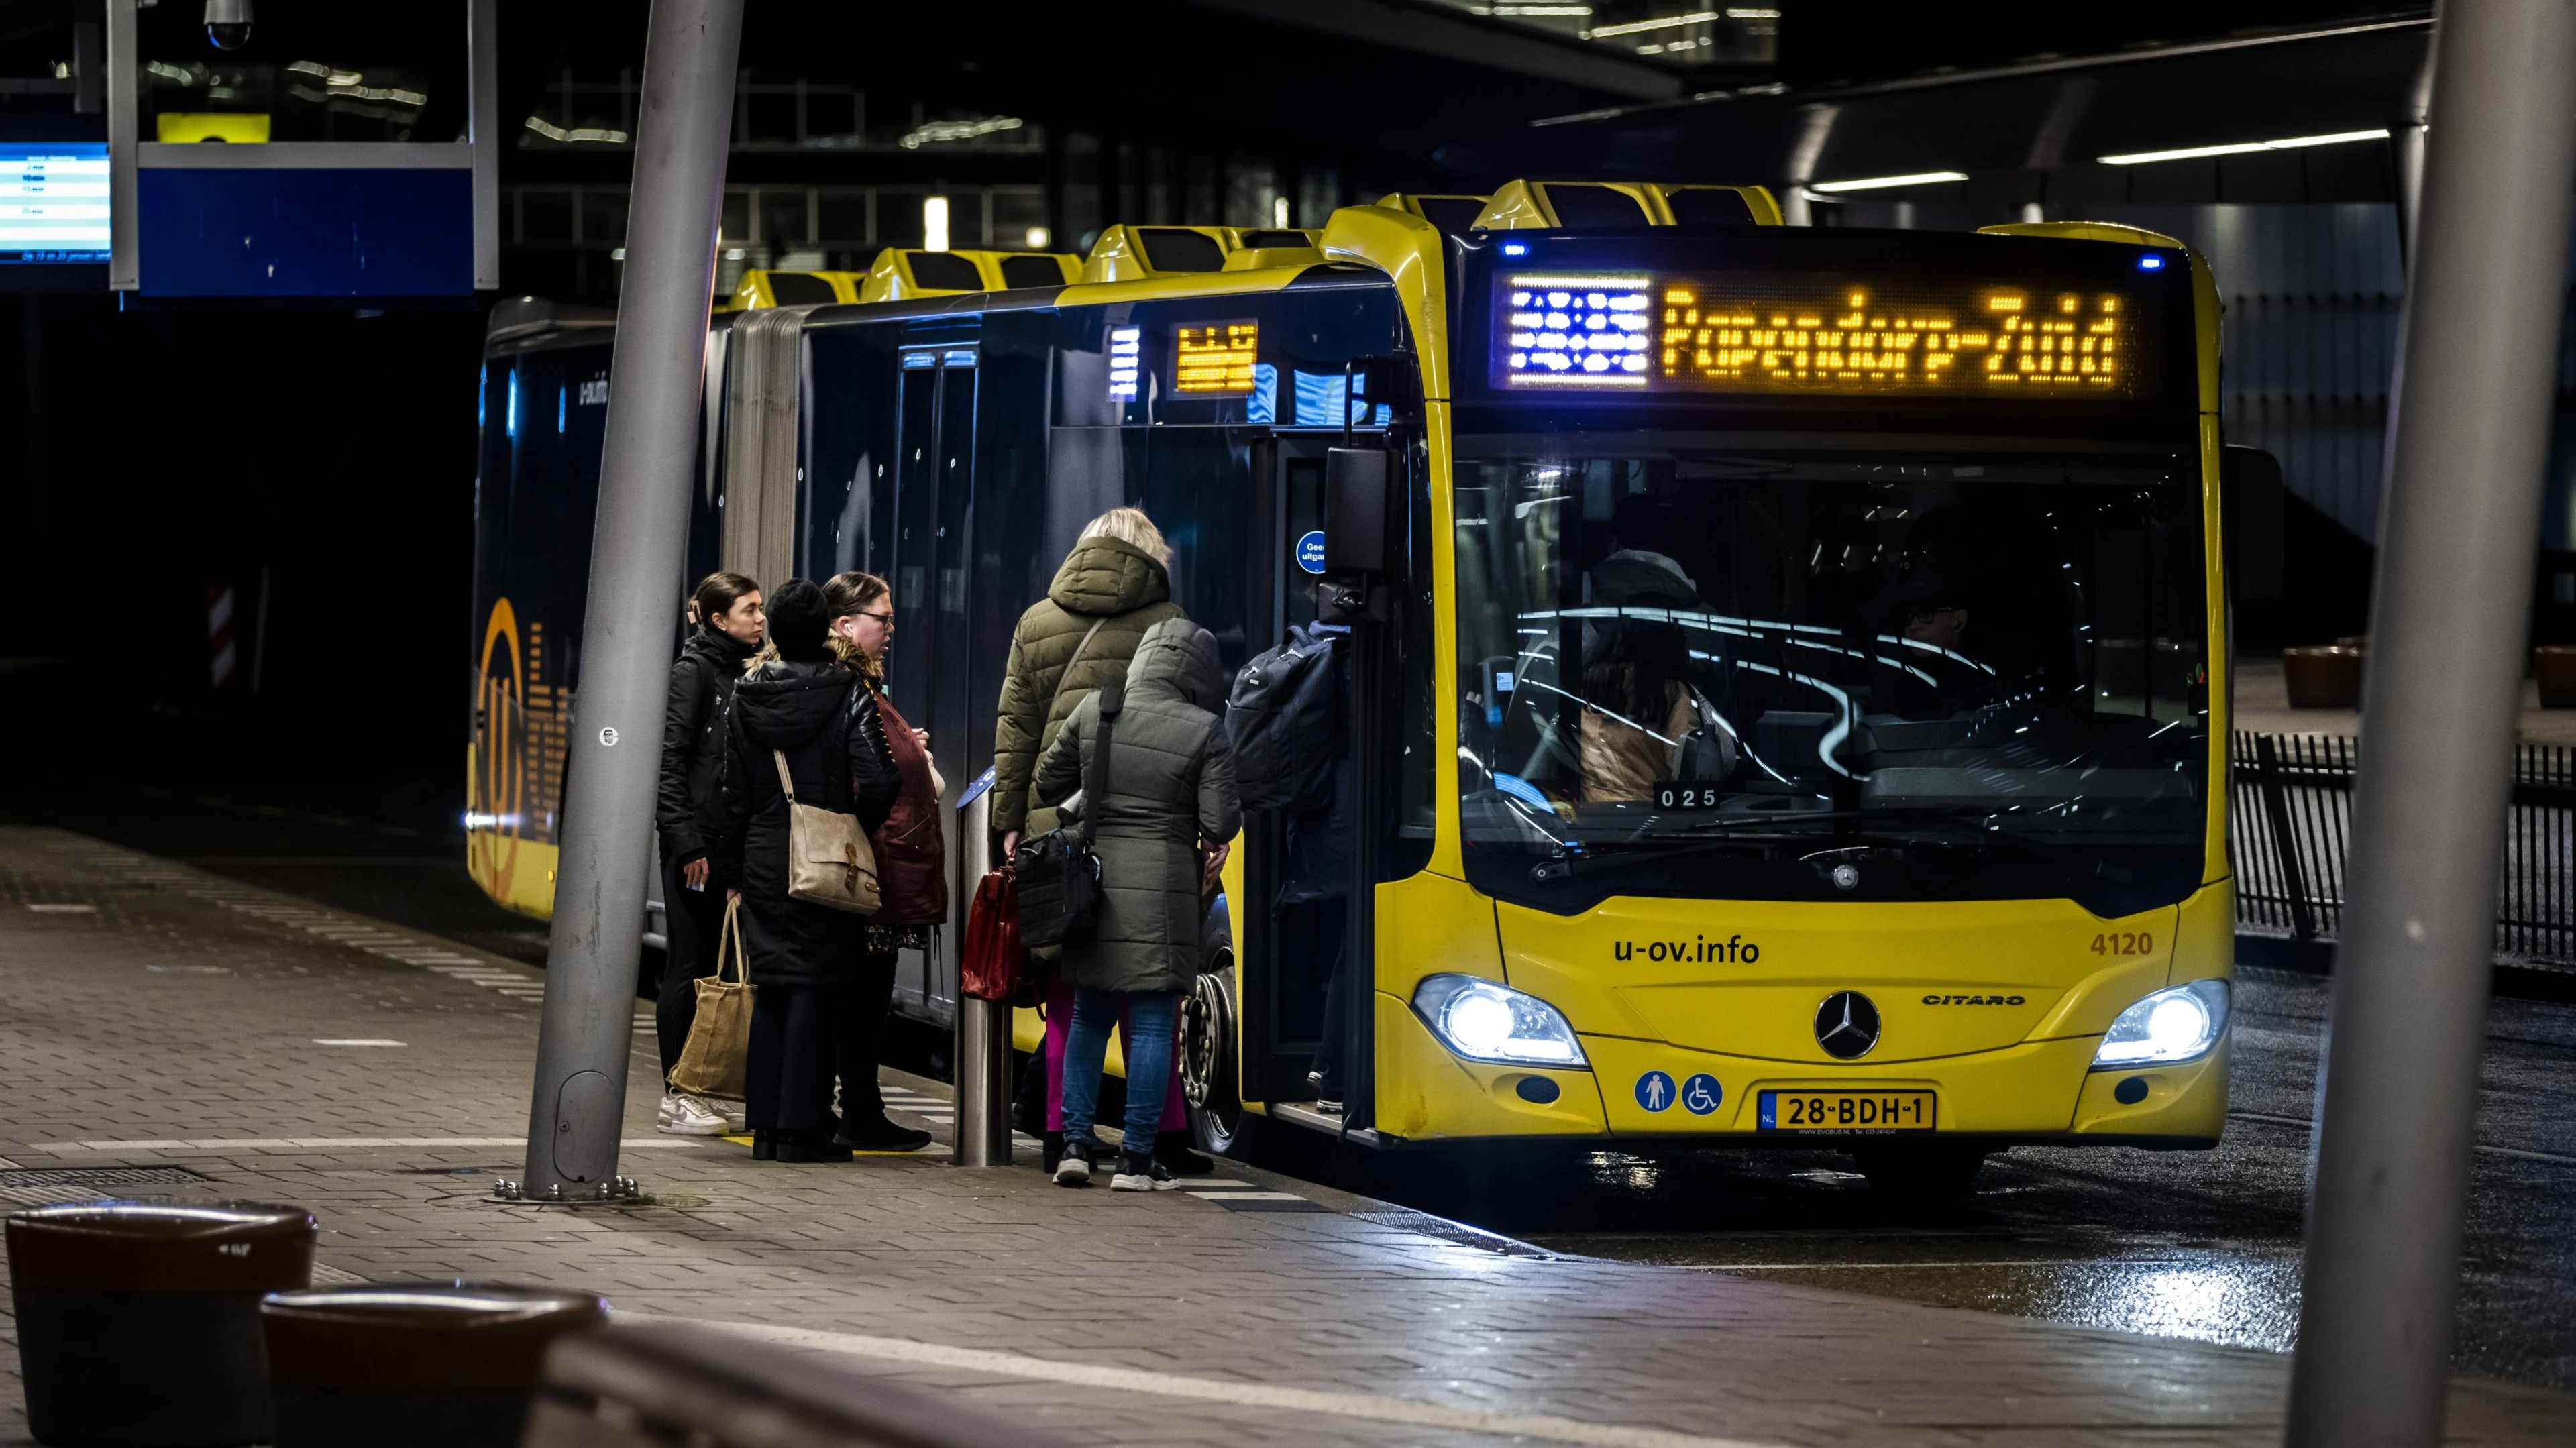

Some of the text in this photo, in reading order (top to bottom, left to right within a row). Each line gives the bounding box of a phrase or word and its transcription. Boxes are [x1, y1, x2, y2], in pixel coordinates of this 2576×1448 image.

[1661, 789, 1716, 807] 025
[1614, 934, 1760, 964] u-ov.info
[2090, 932, 2153, 956] 4120
[1921, 995, 2026, 1006] CITARO
[1762, 1114, 1774, 1123] NL
[1787, 1097, 1922, 1125] 28-BDH-1
